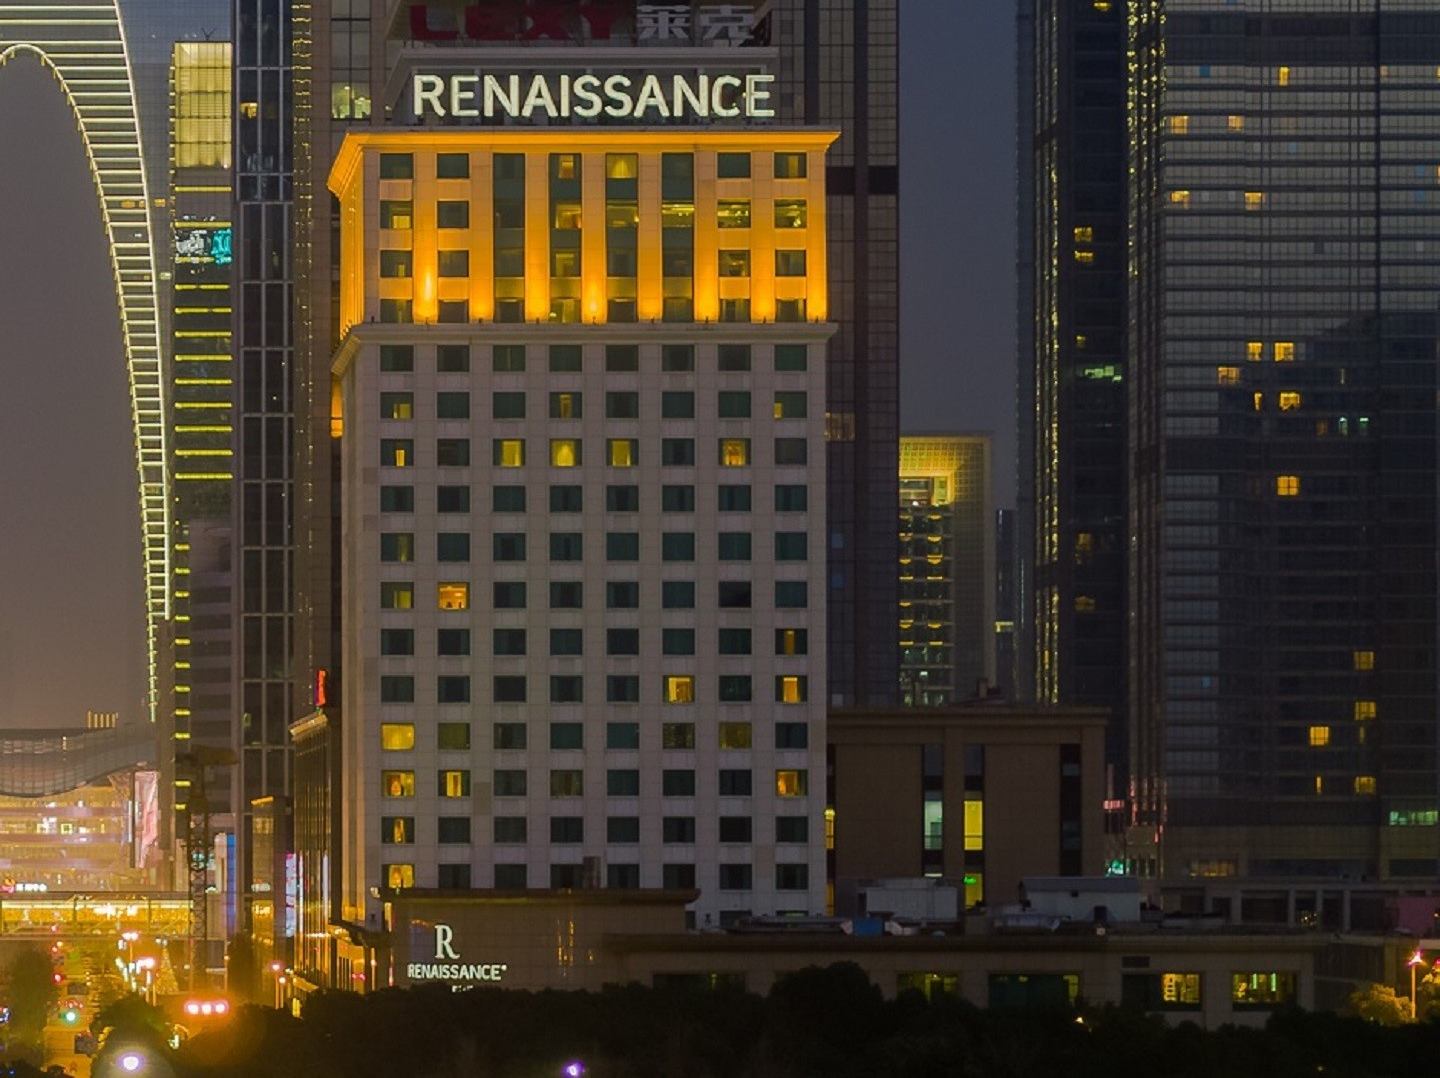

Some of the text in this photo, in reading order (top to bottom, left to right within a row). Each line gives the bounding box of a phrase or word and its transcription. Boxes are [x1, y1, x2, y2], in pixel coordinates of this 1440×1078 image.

[635, 4, 756, 40] 莱克
[413, 74, 775, 118] RENAISSANCE
[434, 924, 461, 960] R
[407, 962, 502, 981] RENAISSANCE
